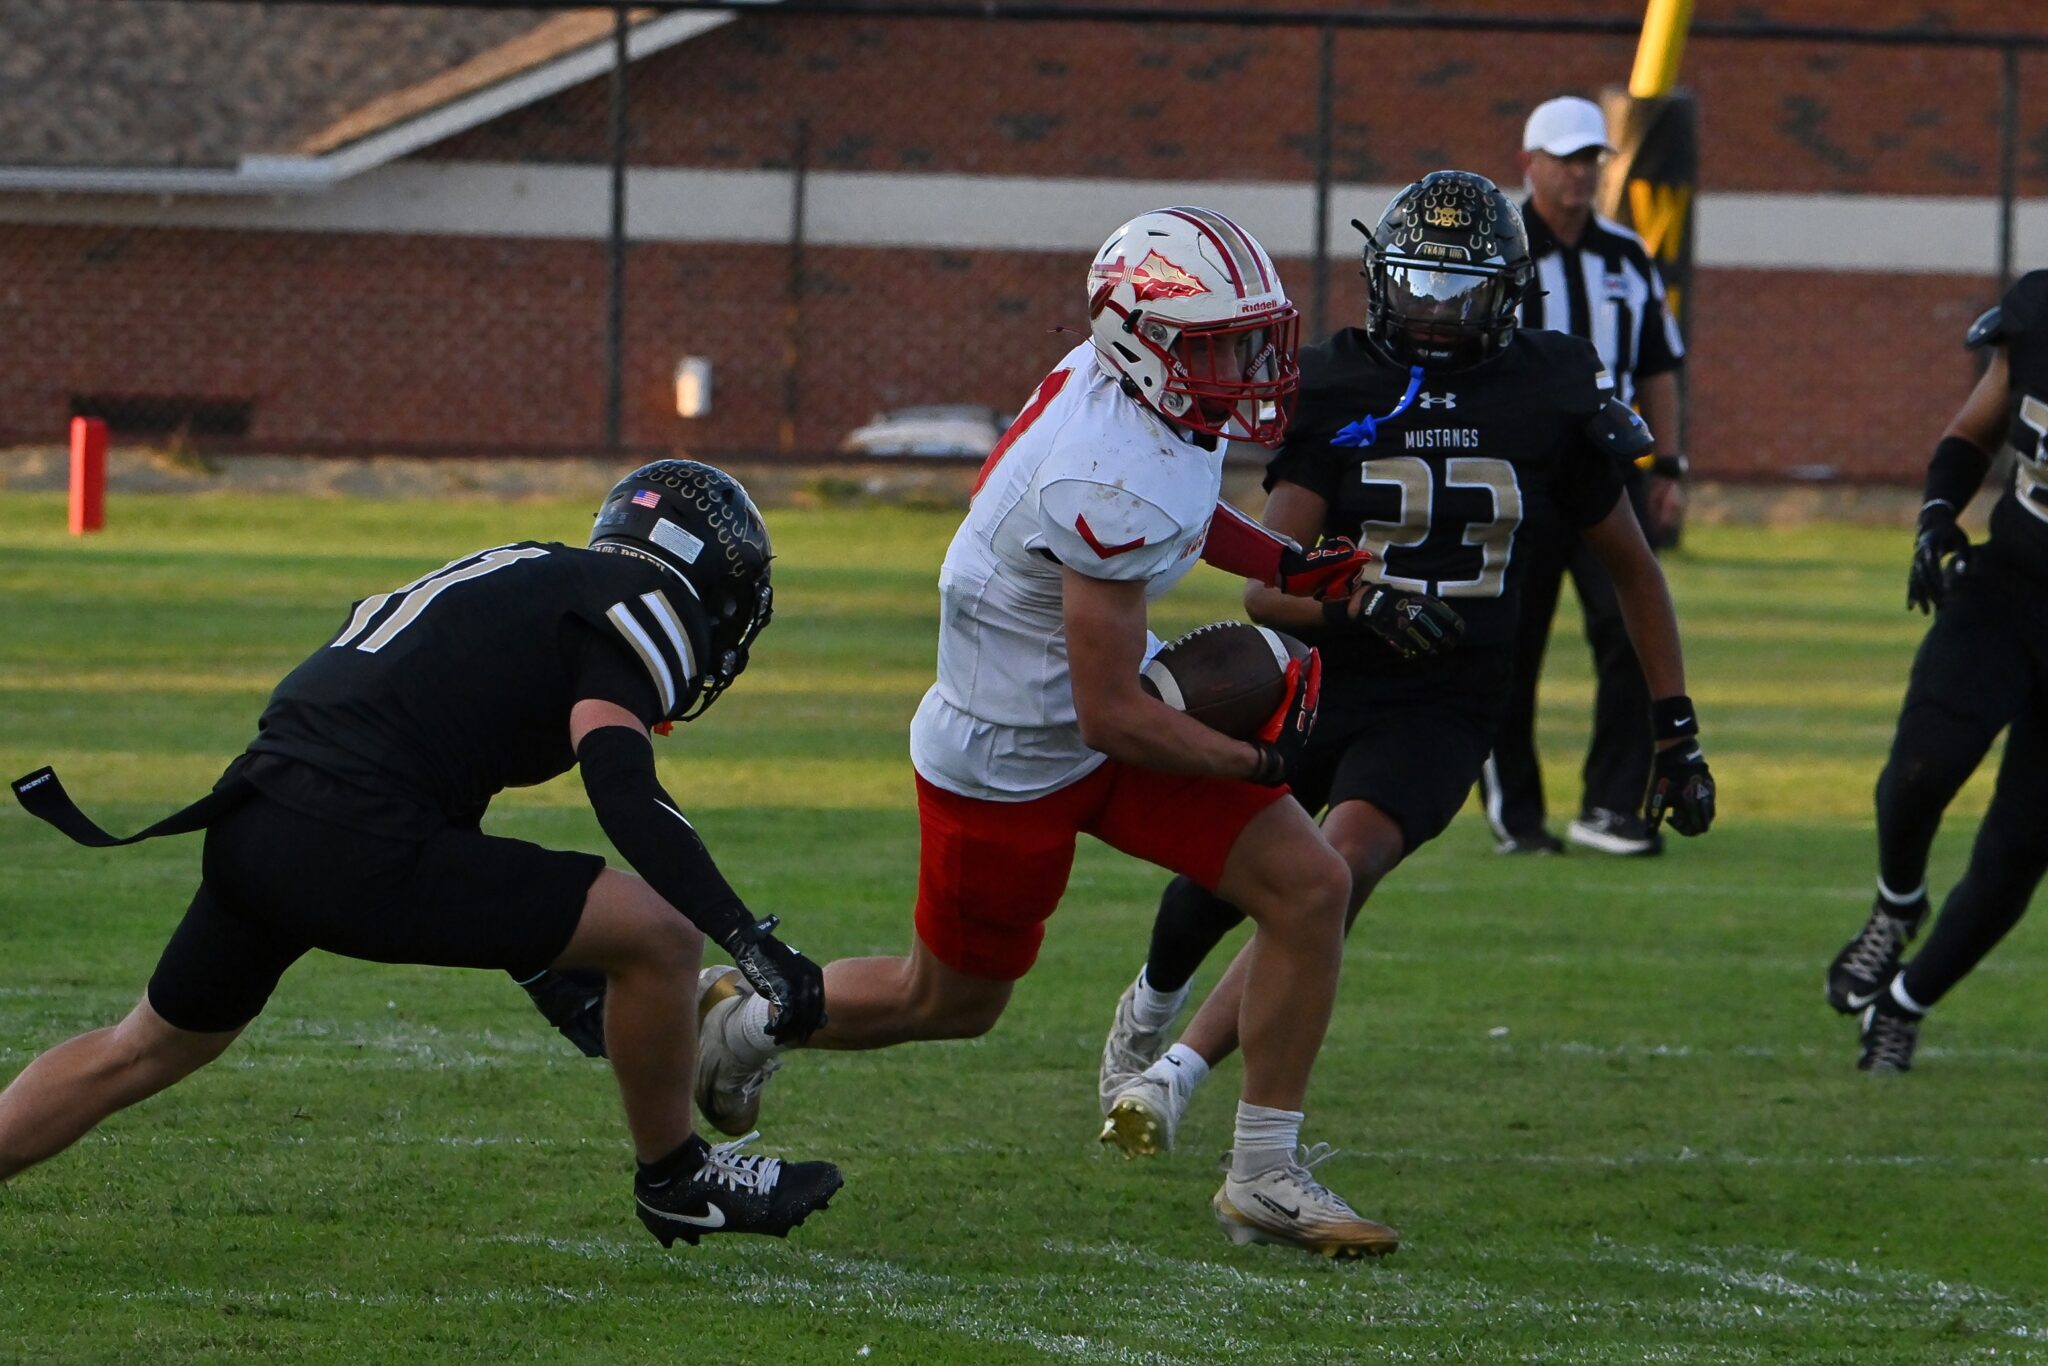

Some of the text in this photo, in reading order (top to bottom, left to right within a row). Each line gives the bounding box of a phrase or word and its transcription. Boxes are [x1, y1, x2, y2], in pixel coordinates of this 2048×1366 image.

[1242, 300, 1278, 313] Riddell
[1405, 428, 1479, 449] MUSTANGS
[1357, 455, 1523, 598] 23
